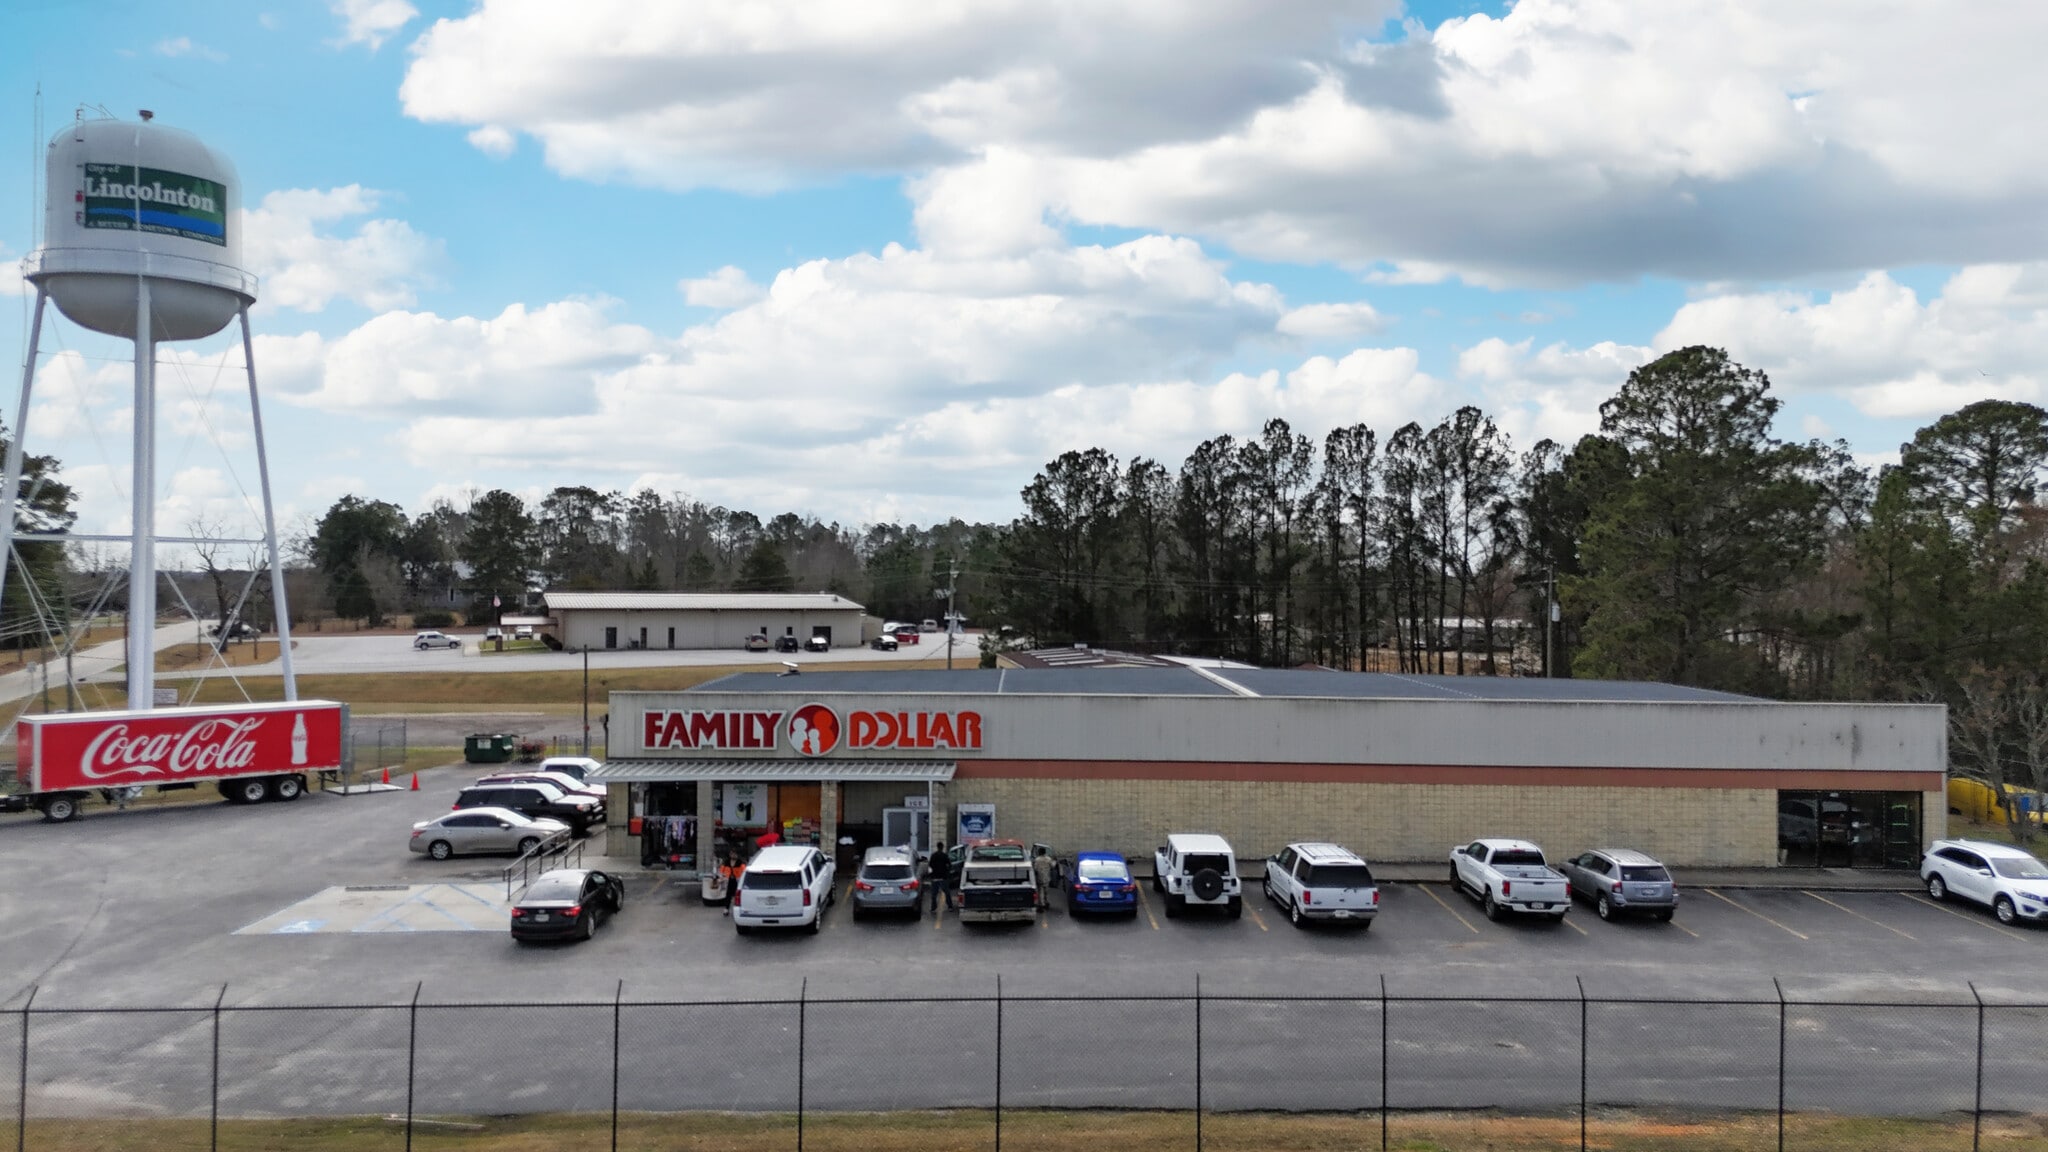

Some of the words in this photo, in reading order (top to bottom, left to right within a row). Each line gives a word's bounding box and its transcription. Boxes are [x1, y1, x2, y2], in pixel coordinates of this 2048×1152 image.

[86, 177, 214, 213] Lincolnton
[81, 717, 266, 779] Coca-Cola
[643, 710, 787, 749] FAMILY
[849, 710, 982, 749] DOLLAR
